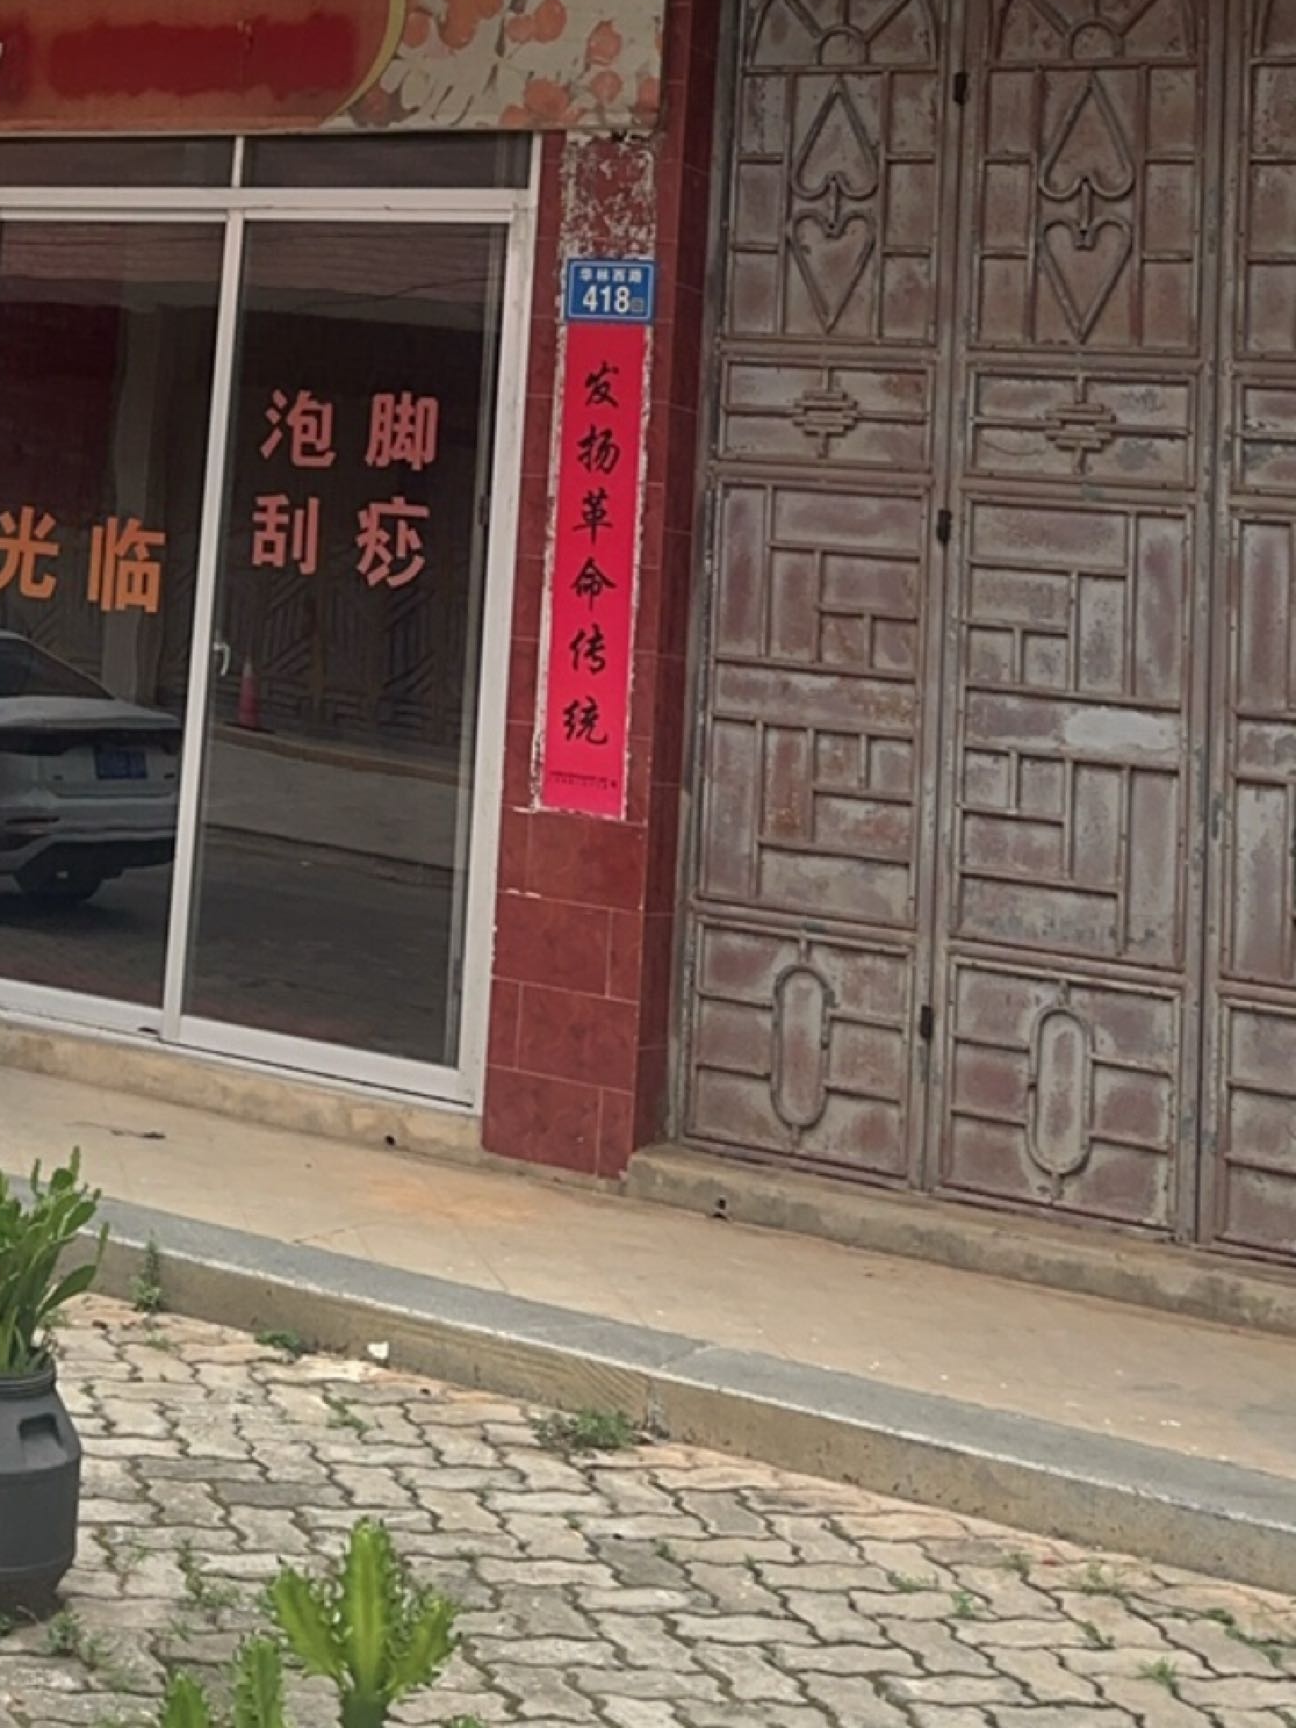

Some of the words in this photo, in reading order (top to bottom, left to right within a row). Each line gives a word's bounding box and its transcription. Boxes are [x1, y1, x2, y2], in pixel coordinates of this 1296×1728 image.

[260, 389, 439, 471] 泡脚
[251, 494, 431, 588] 刮痧
[561, 362, 621, 745] 发扬革命传统
